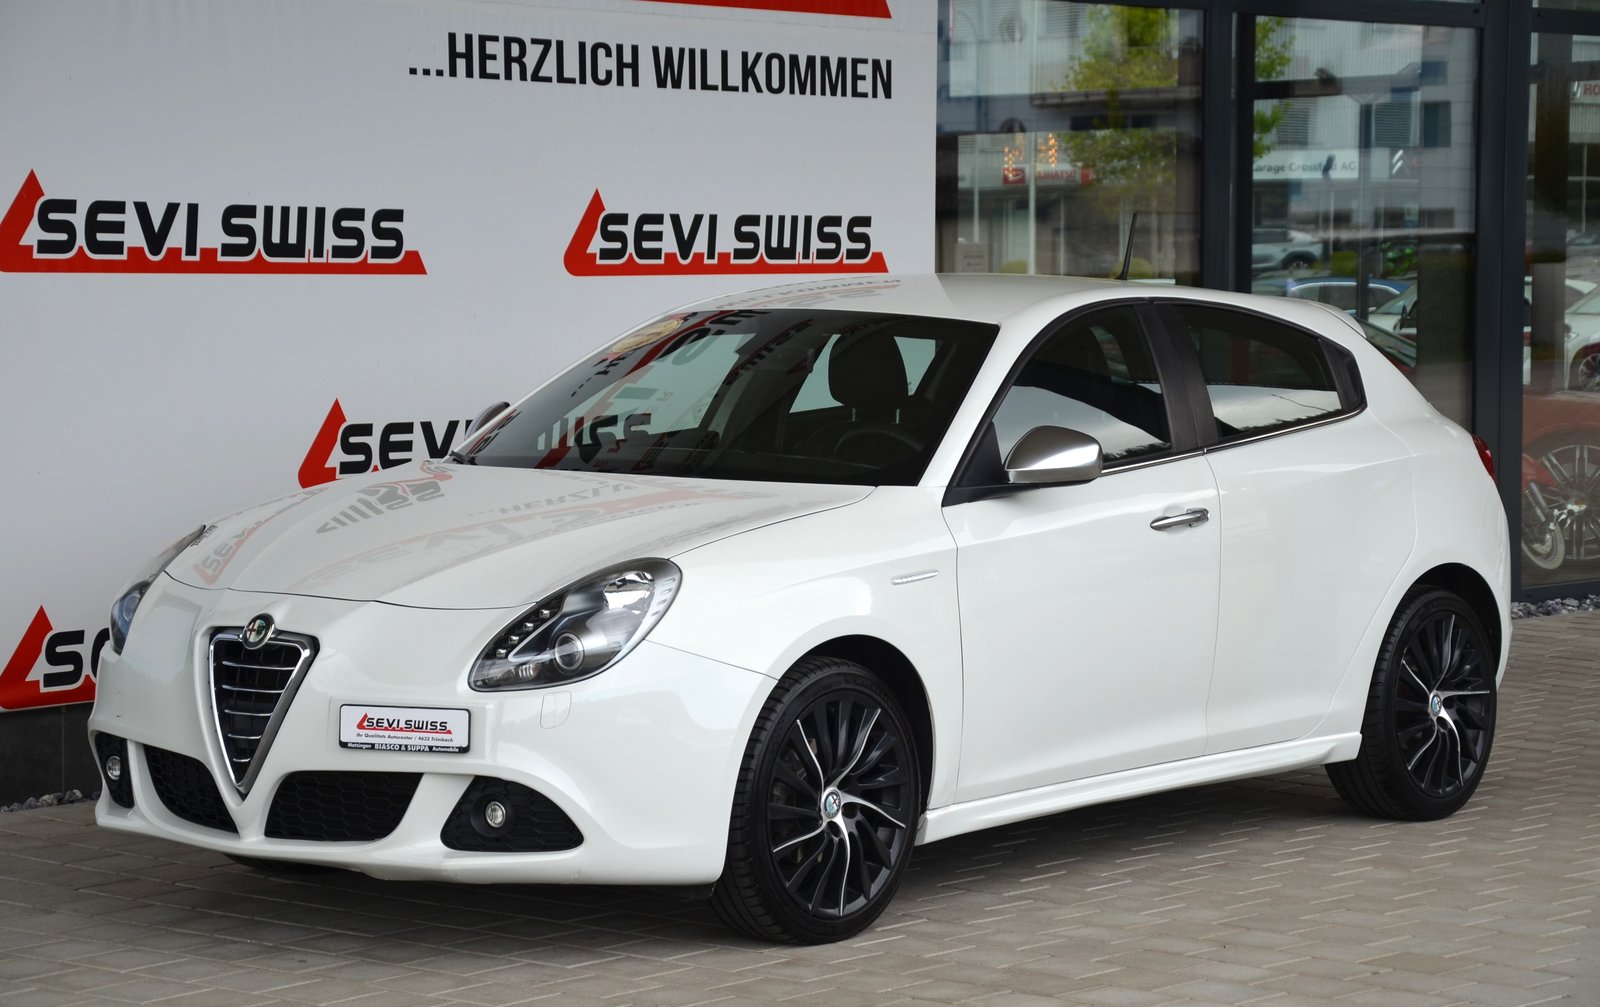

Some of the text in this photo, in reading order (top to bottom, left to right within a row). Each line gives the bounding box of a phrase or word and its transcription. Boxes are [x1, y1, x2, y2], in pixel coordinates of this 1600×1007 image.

[651, 45, 893, 99] WILLKOMMEN
[36, 198, 404, 259] SEVI SWISS
[599, 213, 872, 261] SEVI SWISS
[365, 717, 448, 731] SEVI SWISS
[374, 743, 400, 751] BIASCO
[407, 744, 430, 752] SUPPA
